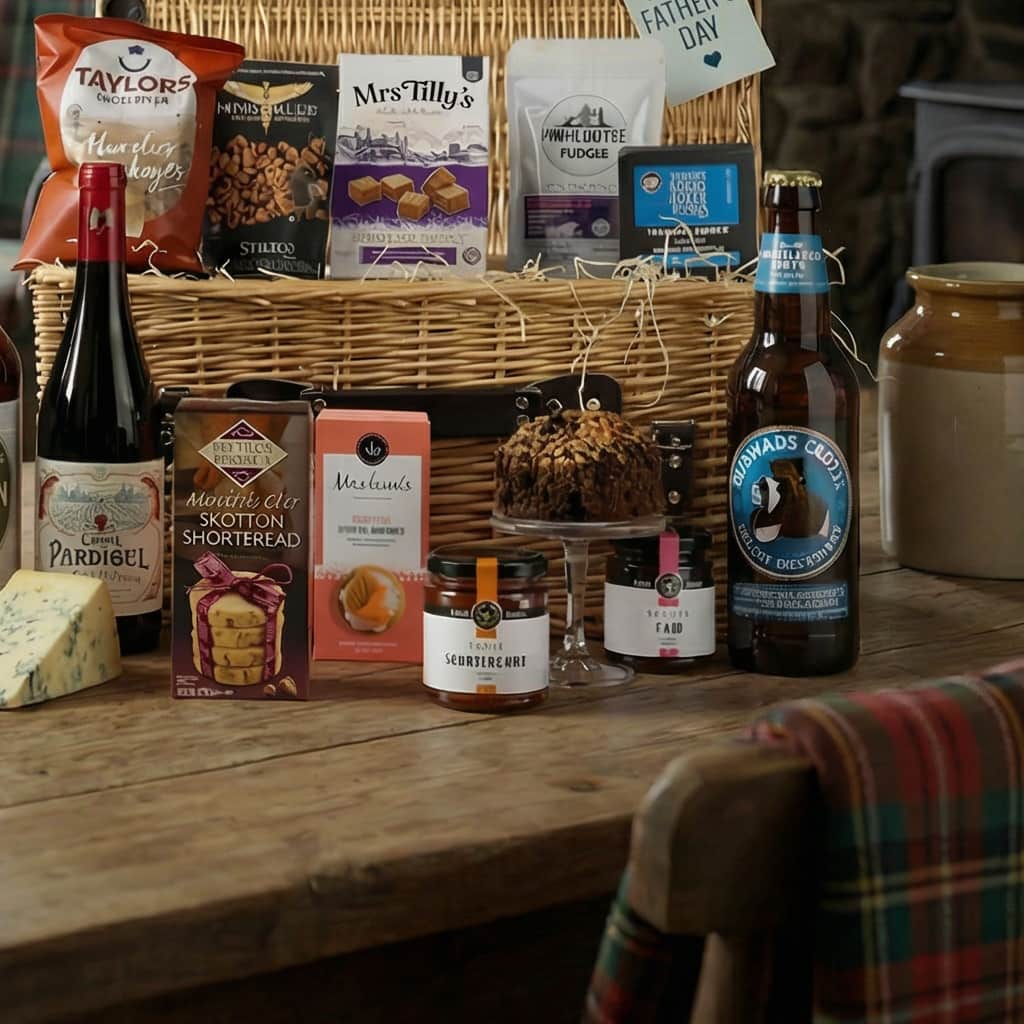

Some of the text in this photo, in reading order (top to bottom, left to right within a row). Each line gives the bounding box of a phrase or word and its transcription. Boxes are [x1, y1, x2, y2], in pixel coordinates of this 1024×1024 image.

[678, 14, 720, 51] DAY
[74, 66, 192, 94] TAYLORS
[199, 512, 284, 528] SKOTTON
